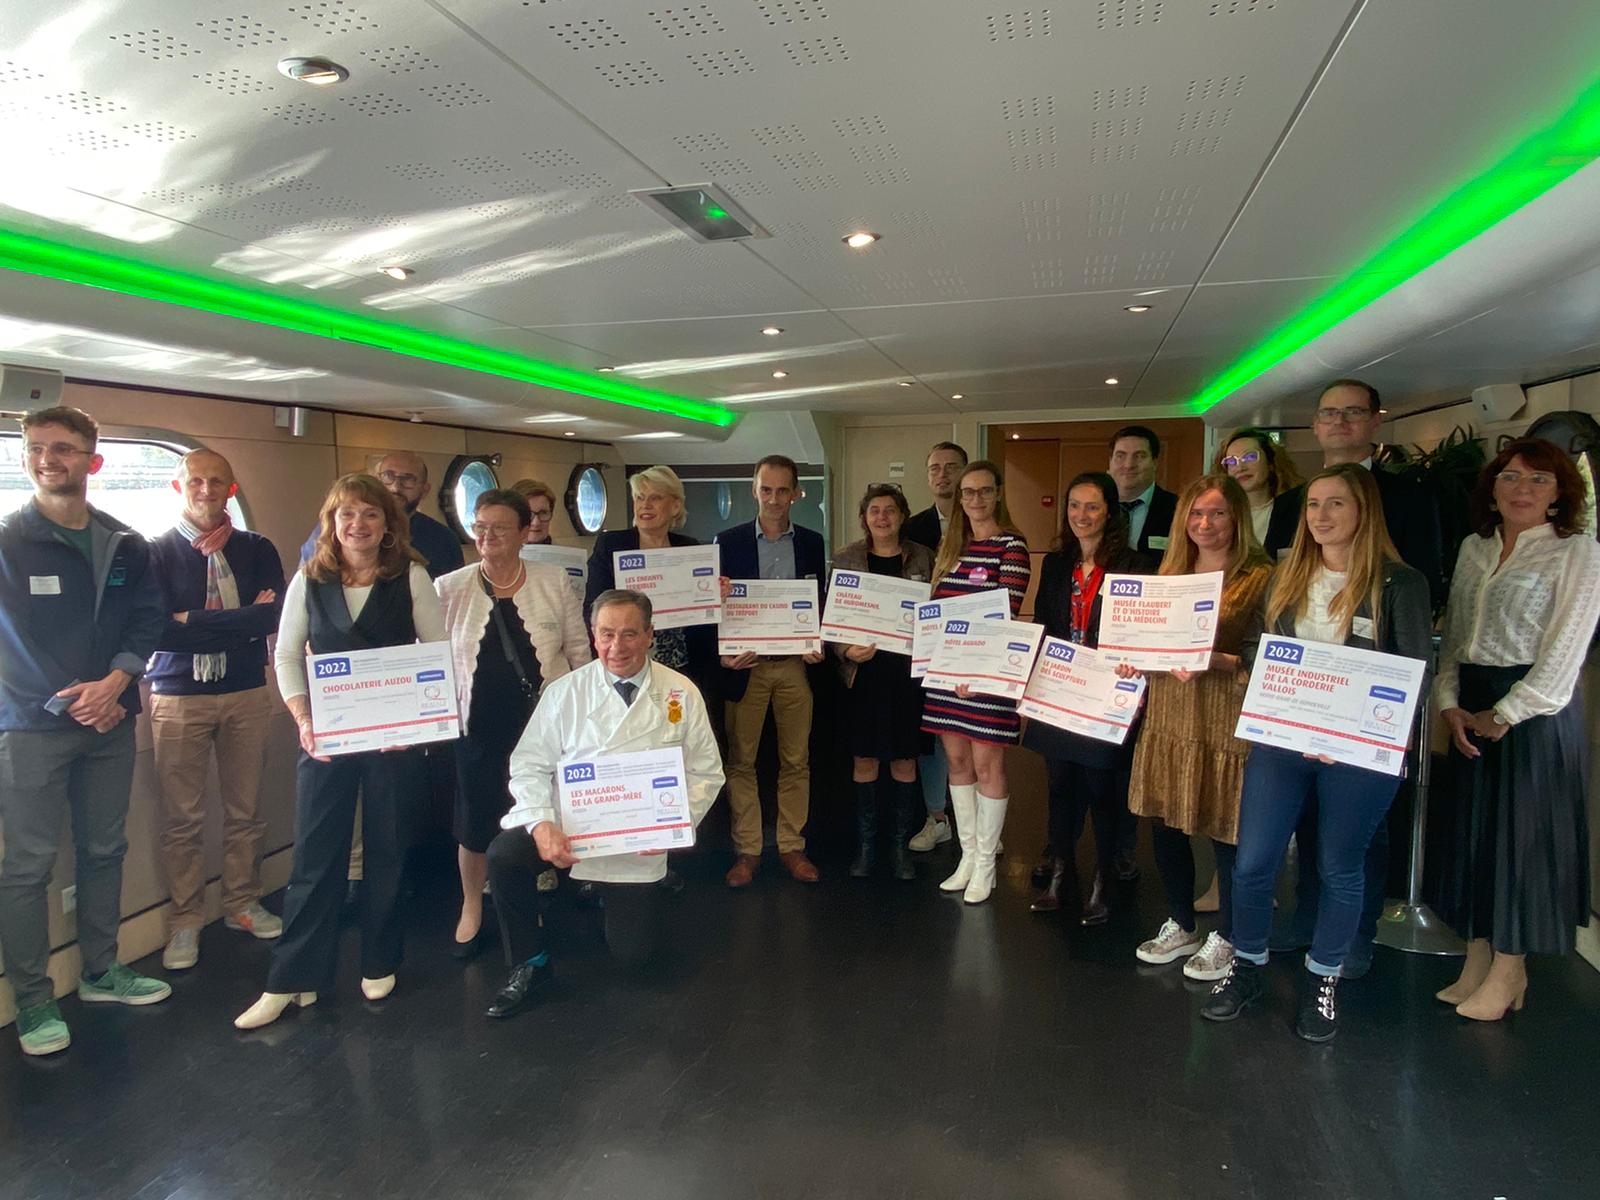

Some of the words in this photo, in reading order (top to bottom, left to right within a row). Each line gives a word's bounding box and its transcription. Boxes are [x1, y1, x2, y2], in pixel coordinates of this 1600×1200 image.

[621, 558, 643, 568] 2022
[625, 576, 635, 584] LES
[837, 576, 857, 586] 2022
[730, 587, 744, 595] 022
[1113, 583, 1138, 594] 2022
[836, 592, 862, 600] CHÂTEAU
[1138, 600, 1172, 608] FLAUBERT
[920, 608, 939, 618] 2022
[1122, 608, 1160, 616] D'HISTOIRE
[1134, 615, 1167, 624] MÉDECINE
[946, 623, 967, 632] 2022
[1048, 646, 1072, 660] 2022
[1268, 645, 1299, 661] 2022
[318, 661, 347, 675] 2022
[1050, 661, 1072, 673] JARDIN
[1040, 667, 1051, 675] DES
[1052, 670, 1087, 686] SCULPTURES
[1266, 664, 1295, 676] MUSÉE
[1297, 670, 1350, 686] INDUSTRIEL
[322, 679, 382, 694] CHOCOLATERIE
[384, 676, 412, 687] AUZOU
[1262, 682, 1296, 696] VALLOIS
[1264, 674, 1276, 683] DE
[1277, 675, 1288, 684] LA
[1291, 678, 1335, 693] CORDERIE
[567, 767, 592, 780] 2022
[570, 789, 583, 798] LES
[584, 785, 626, 796] MACARONS
[572, 798, 581, 807] DE
[583, 798, 592, 806] LA
[594, 791, 643, 804] GRAND-MÈRE
